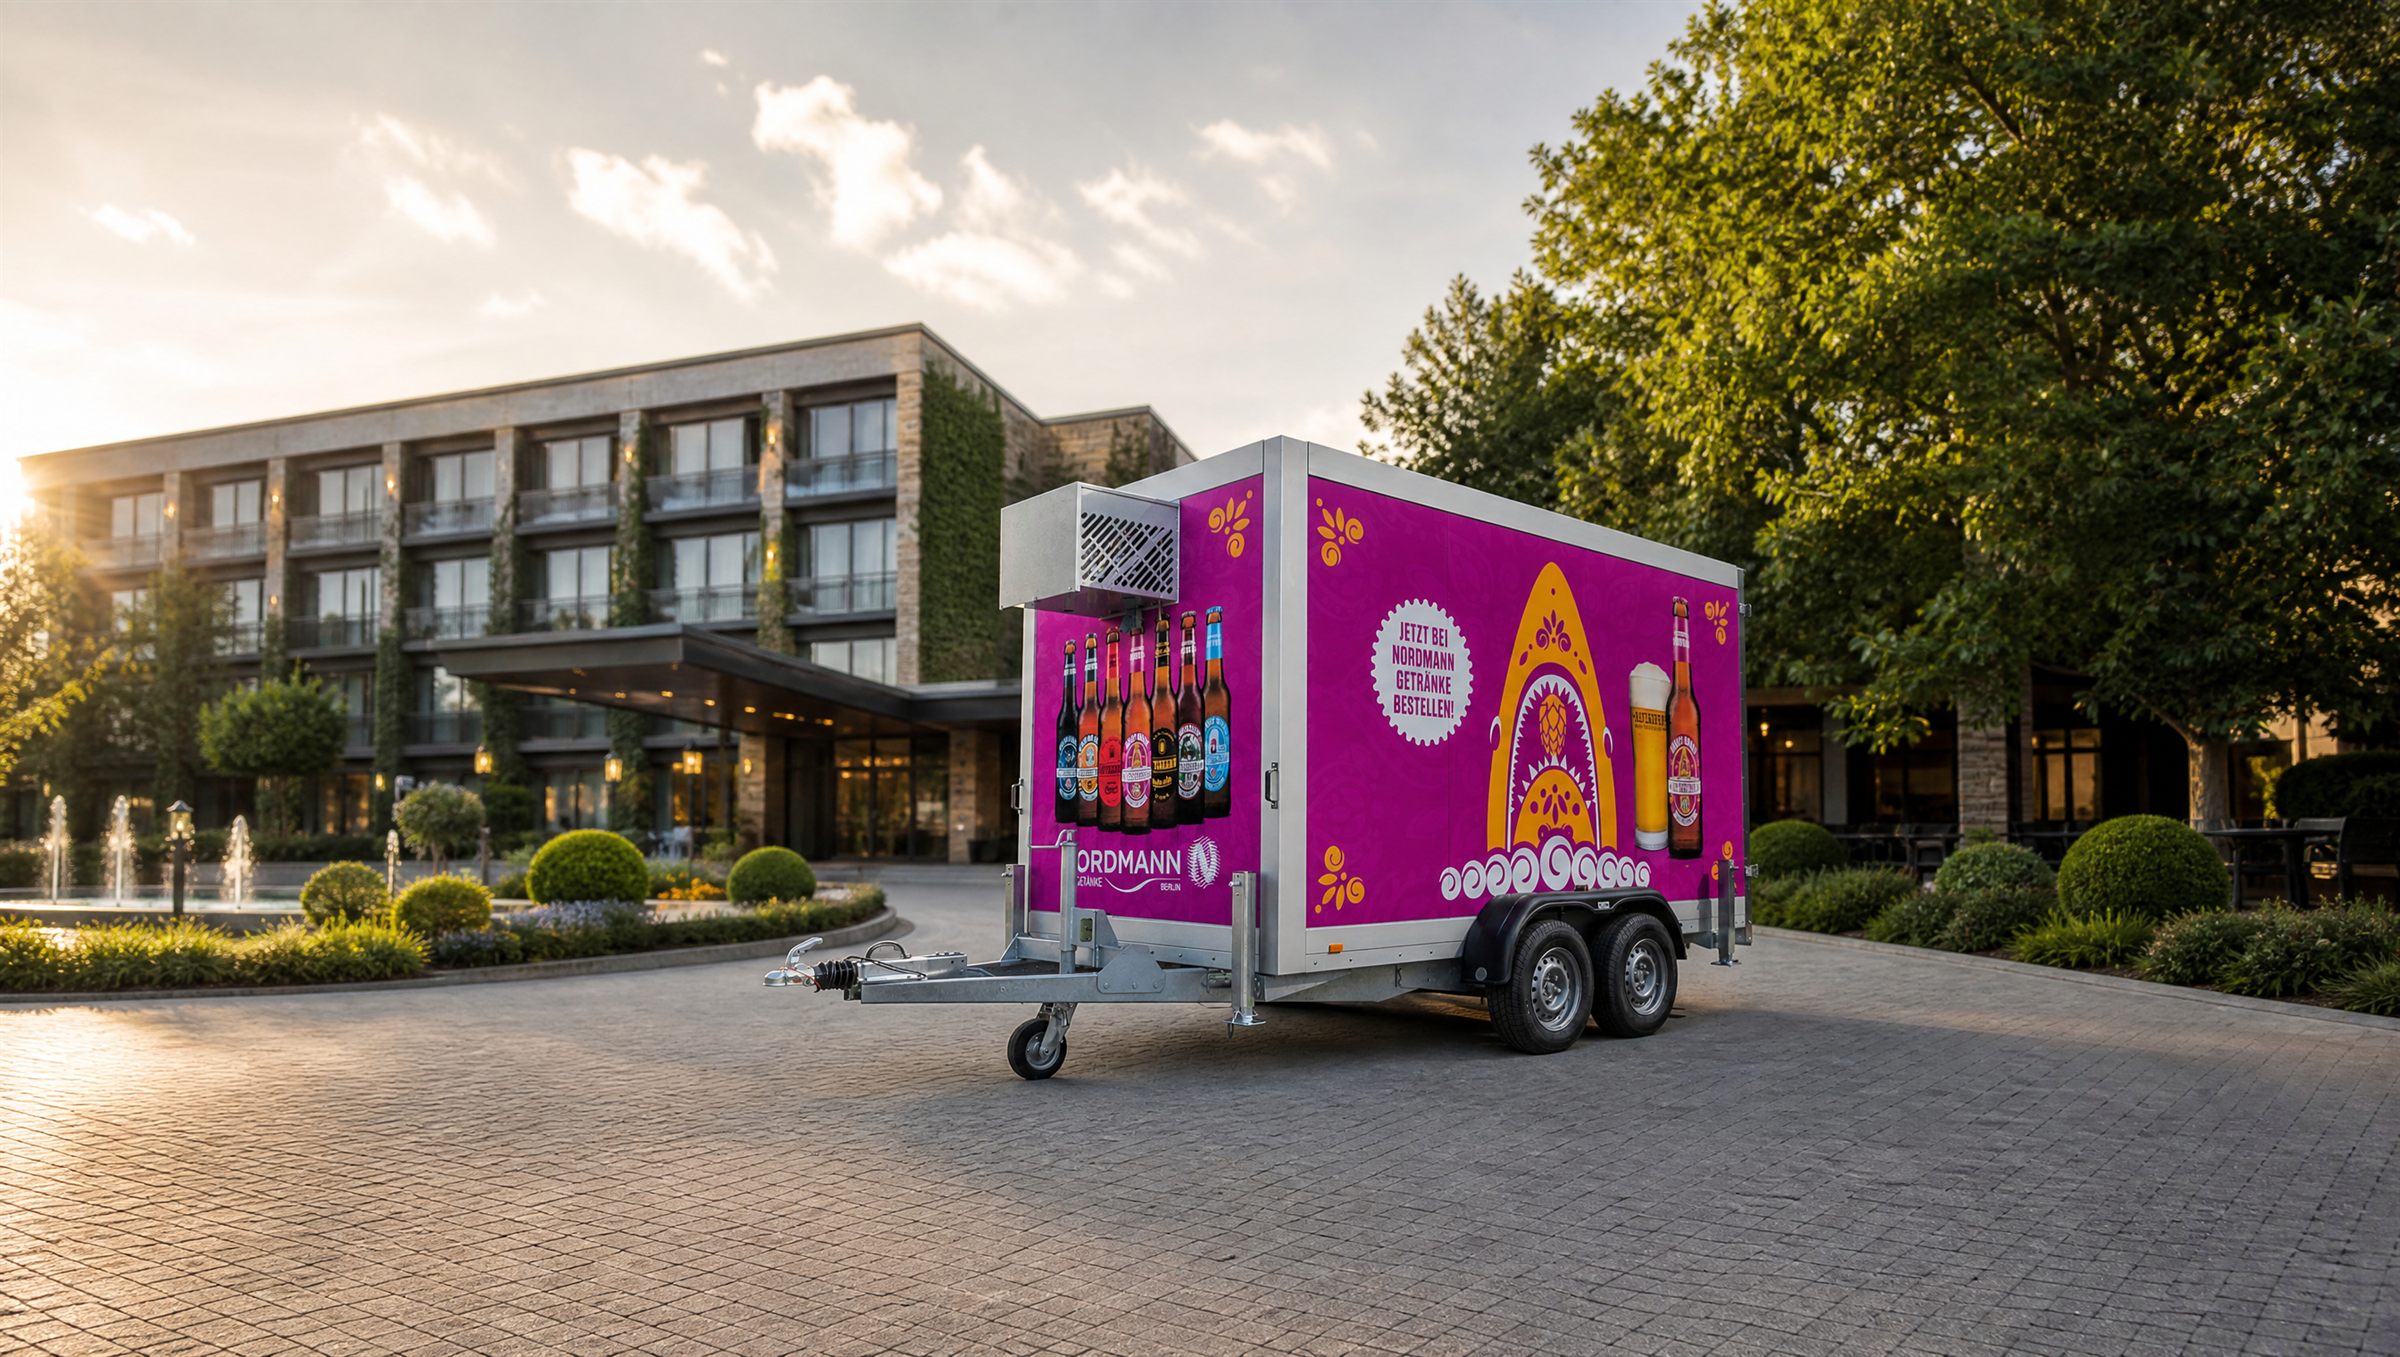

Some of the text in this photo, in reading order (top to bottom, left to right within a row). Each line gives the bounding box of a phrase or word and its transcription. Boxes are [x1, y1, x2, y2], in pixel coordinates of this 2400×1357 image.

[1400, 621, 1448, 648] JETZT BEI
[1392, 644, 1455, 672] NORDMANN
[1396, 669, 1452, 695] GETRÄNKE
[1393, 694, 1454, 719] BESTELLEN!
[1077, 849, 1181, 875] ORDMANN
[1160, 882, 1181, 892] BERLIN
